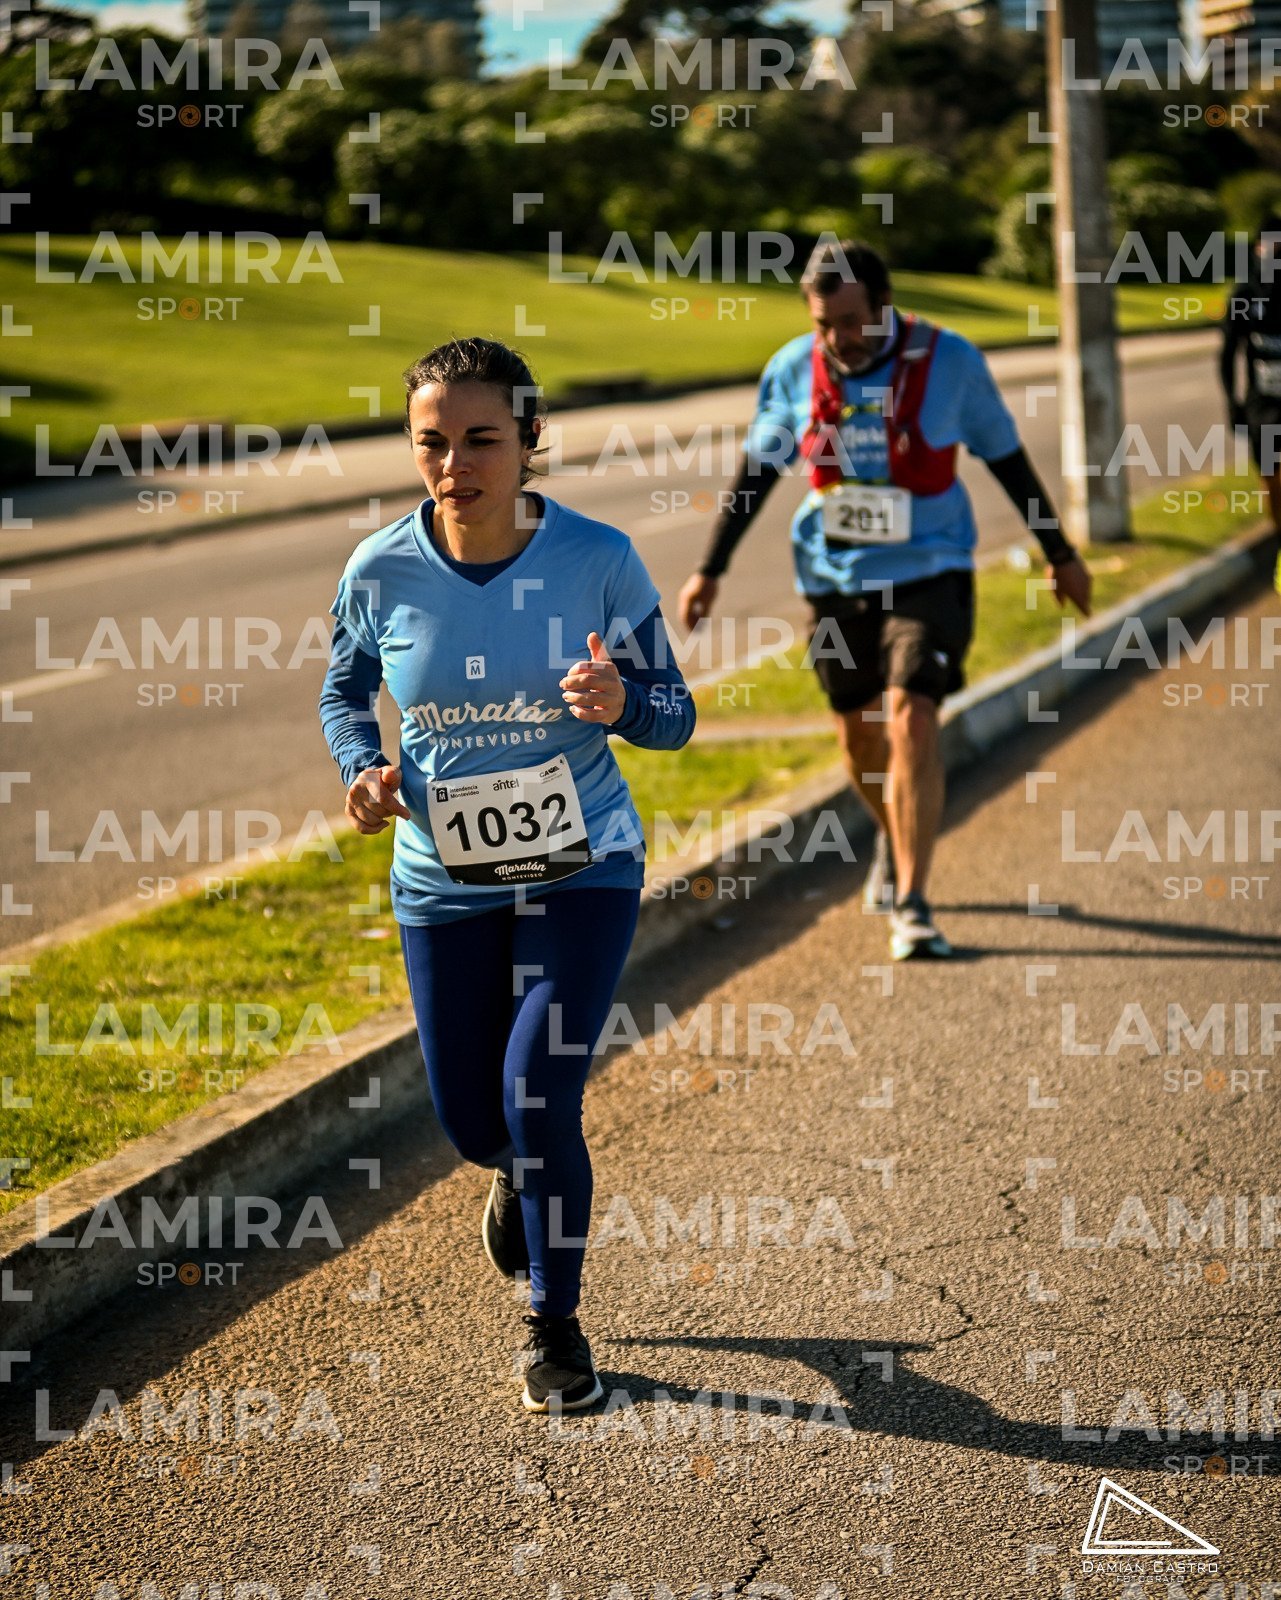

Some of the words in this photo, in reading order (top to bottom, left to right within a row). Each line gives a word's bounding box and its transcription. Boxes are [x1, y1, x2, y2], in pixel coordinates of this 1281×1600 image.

[406, 698, 563, 732] Maratón
[428, 727, 547, 749] MONTEVIDEO
[450, 785, 478, 793] Intendencia
[492, 778, 520, 791] antel
[450, 790, 480, 799] Montevideo
[446, 793, 572, 851] 1032
[494, 861, 547, 876] Maratón
[501, 872, 543, 881] MONTEVIDEO
